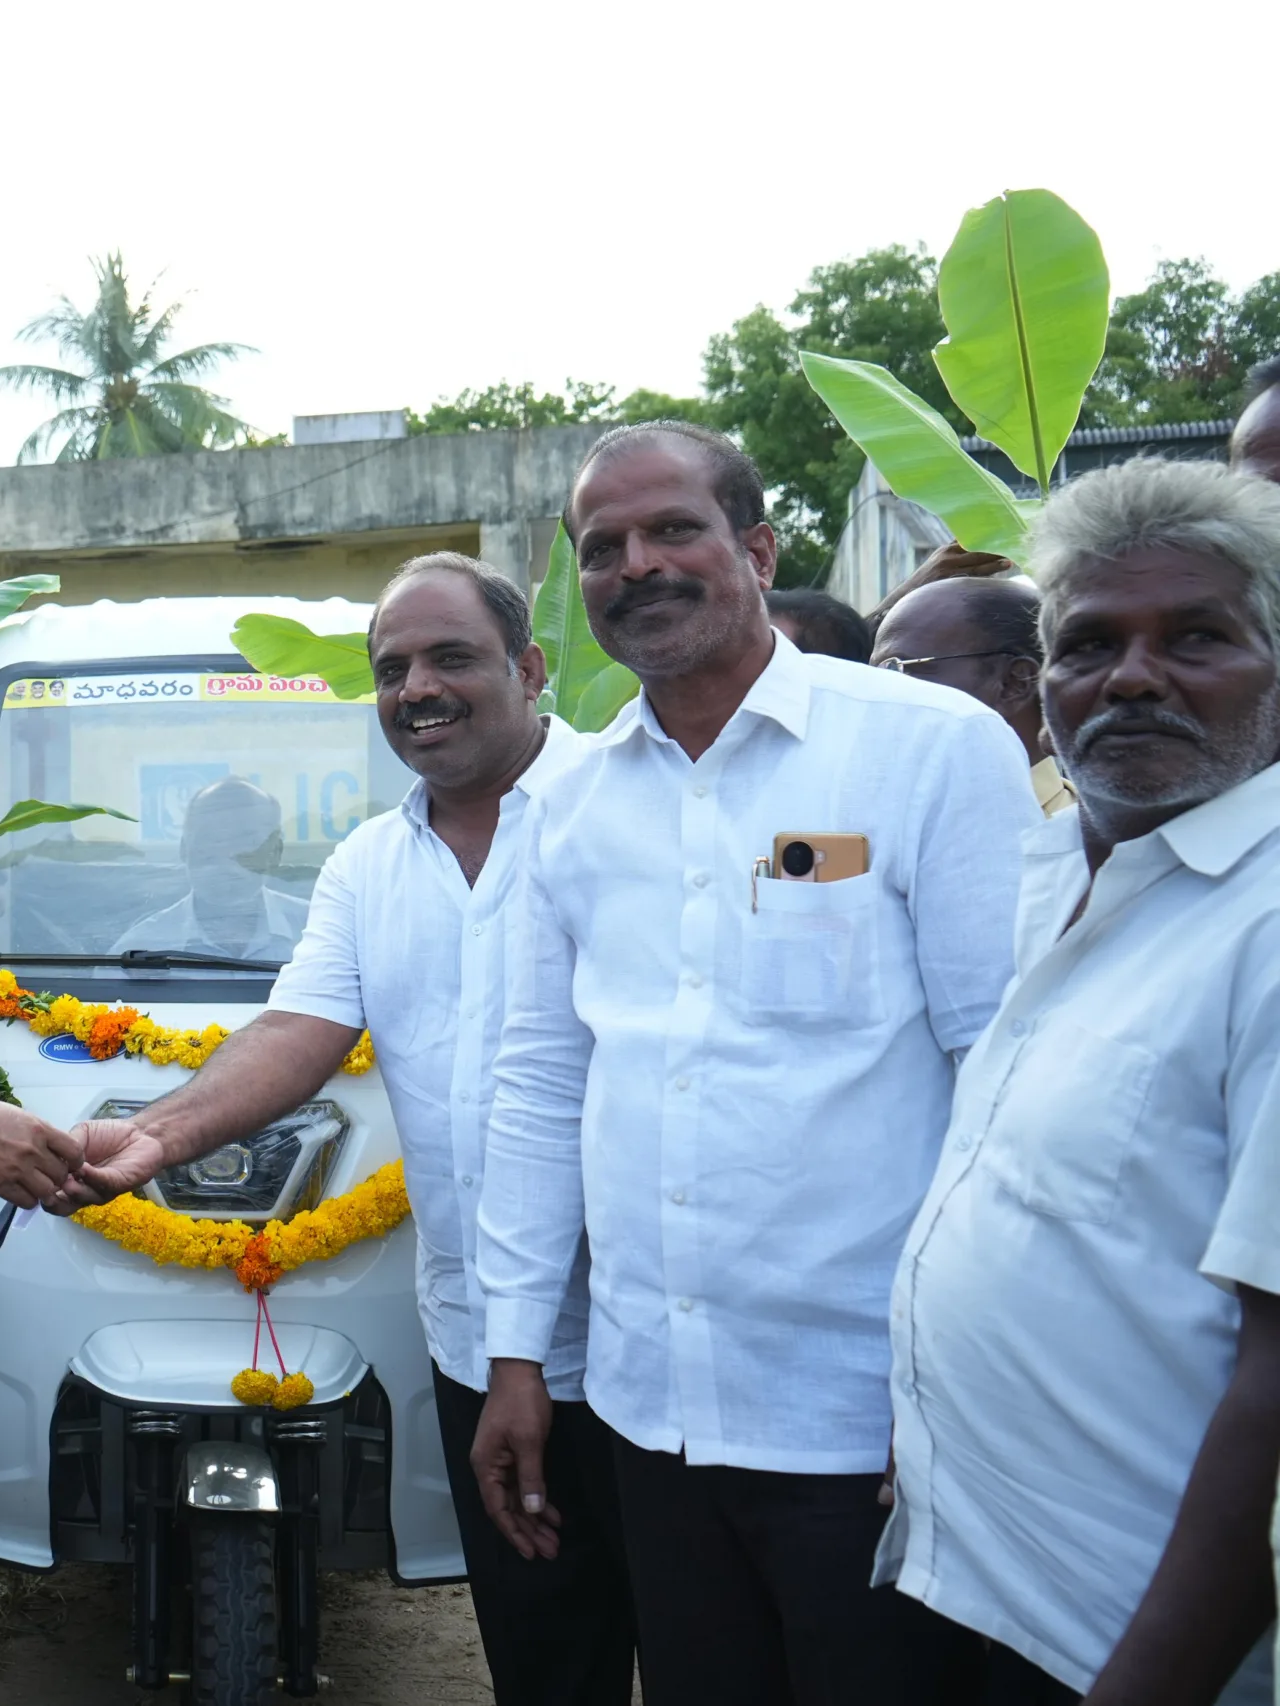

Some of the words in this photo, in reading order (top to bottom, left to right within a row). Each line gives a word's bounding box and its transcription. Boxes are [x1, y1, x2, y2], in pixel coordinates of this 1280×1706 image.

[72, 679, 194, 700] మాధవరం
[206, 674, 263, 696] గ్రామ
[268, 675, 328, 693] పంచ
[53, 1043, 74, 1052] RMW
